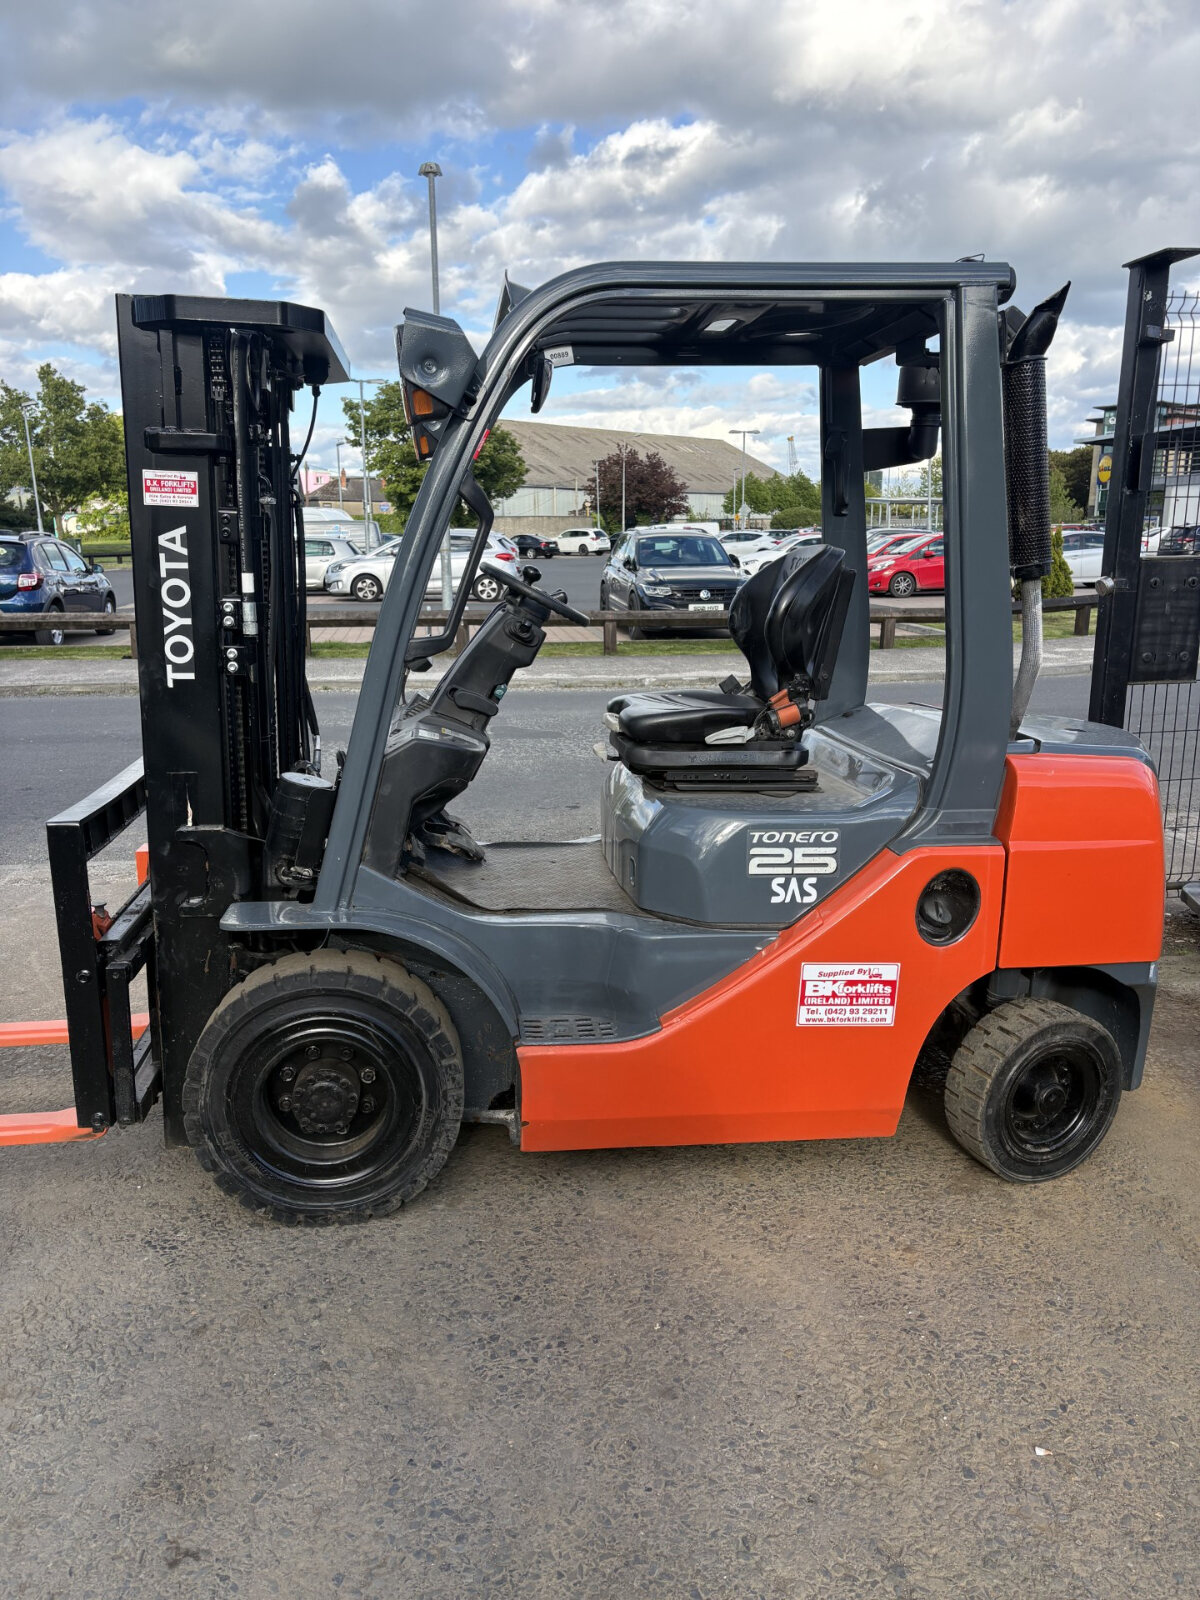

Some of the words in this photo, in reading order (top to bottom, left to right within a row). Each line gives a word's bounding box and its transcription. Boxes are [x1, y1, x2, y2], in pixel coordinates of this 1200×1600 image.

[160, 480, 194, 488] FORKLIFTS
[157, 525, 196, 688] TOYOTA
[749, 831, 839, 843] TONERO
[748, 847, 838, 875] 25
[770, 877, 818, 903] SAS
[817, 968, 855, 978] Supplied
[857, 967, 868, 977] By
[804, 997, 850, 1005] (IRELAND)
[852, 997, 891, 1005] LIMITED
[824, 1007, 847, 1016] (042)
[849, 1007, 860, 1015] 93
[862, 1007, 888, 1015] 29211
